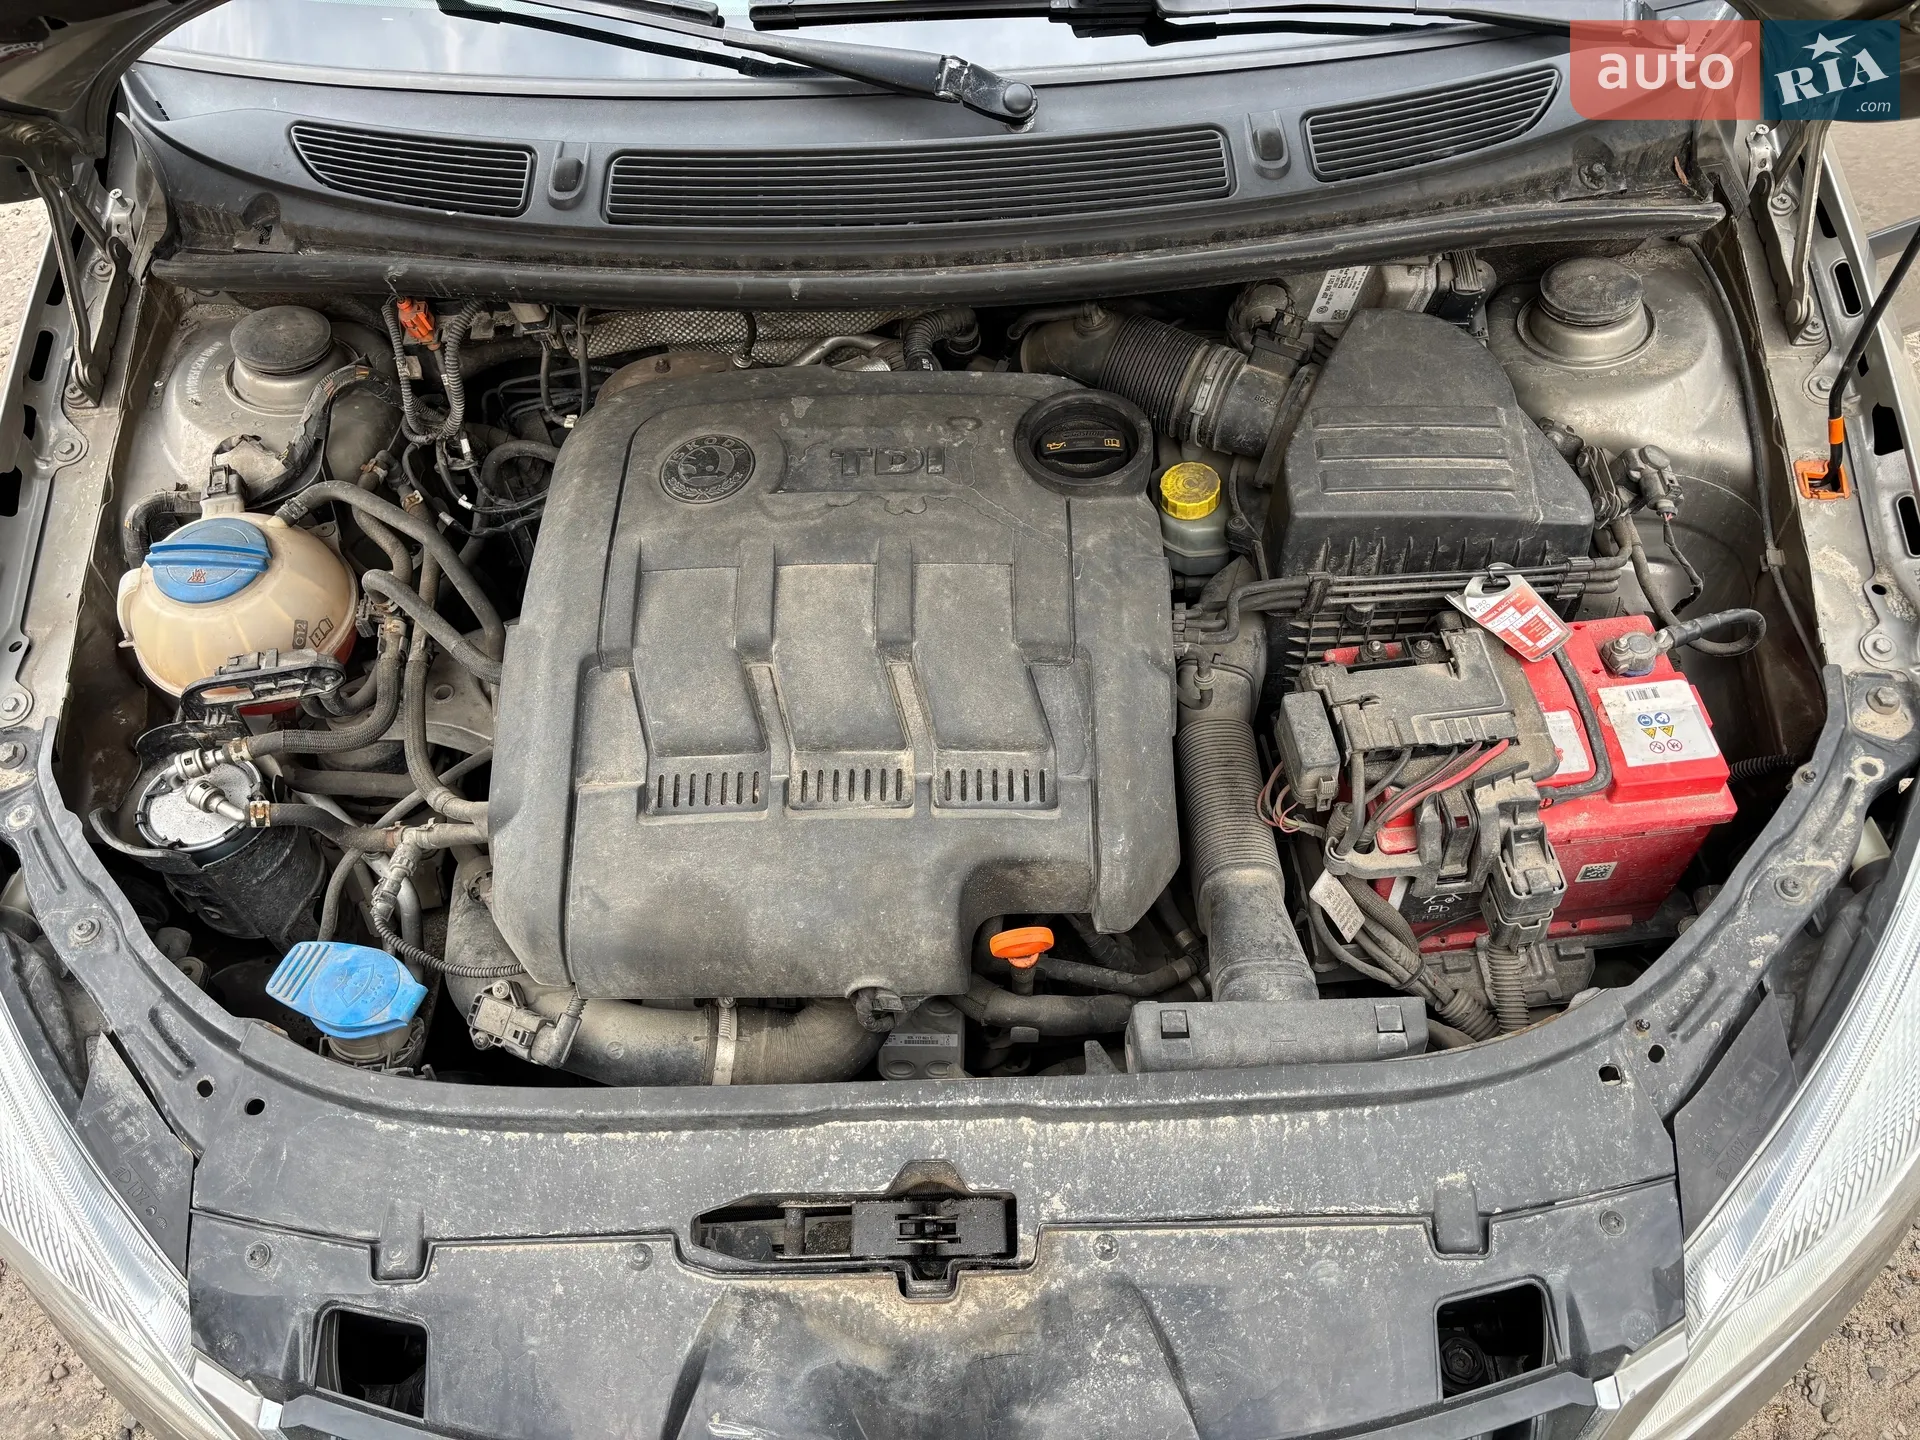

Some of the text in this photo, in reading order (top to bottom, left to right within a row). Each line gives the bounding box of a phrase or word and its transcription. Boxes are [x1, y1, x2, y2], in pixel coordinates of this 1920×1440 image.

[1254, 394, 1279, 408] BOSCH
[829, 446, 946, 477] TDI
[1427, 904, 1450, 913] Pb
